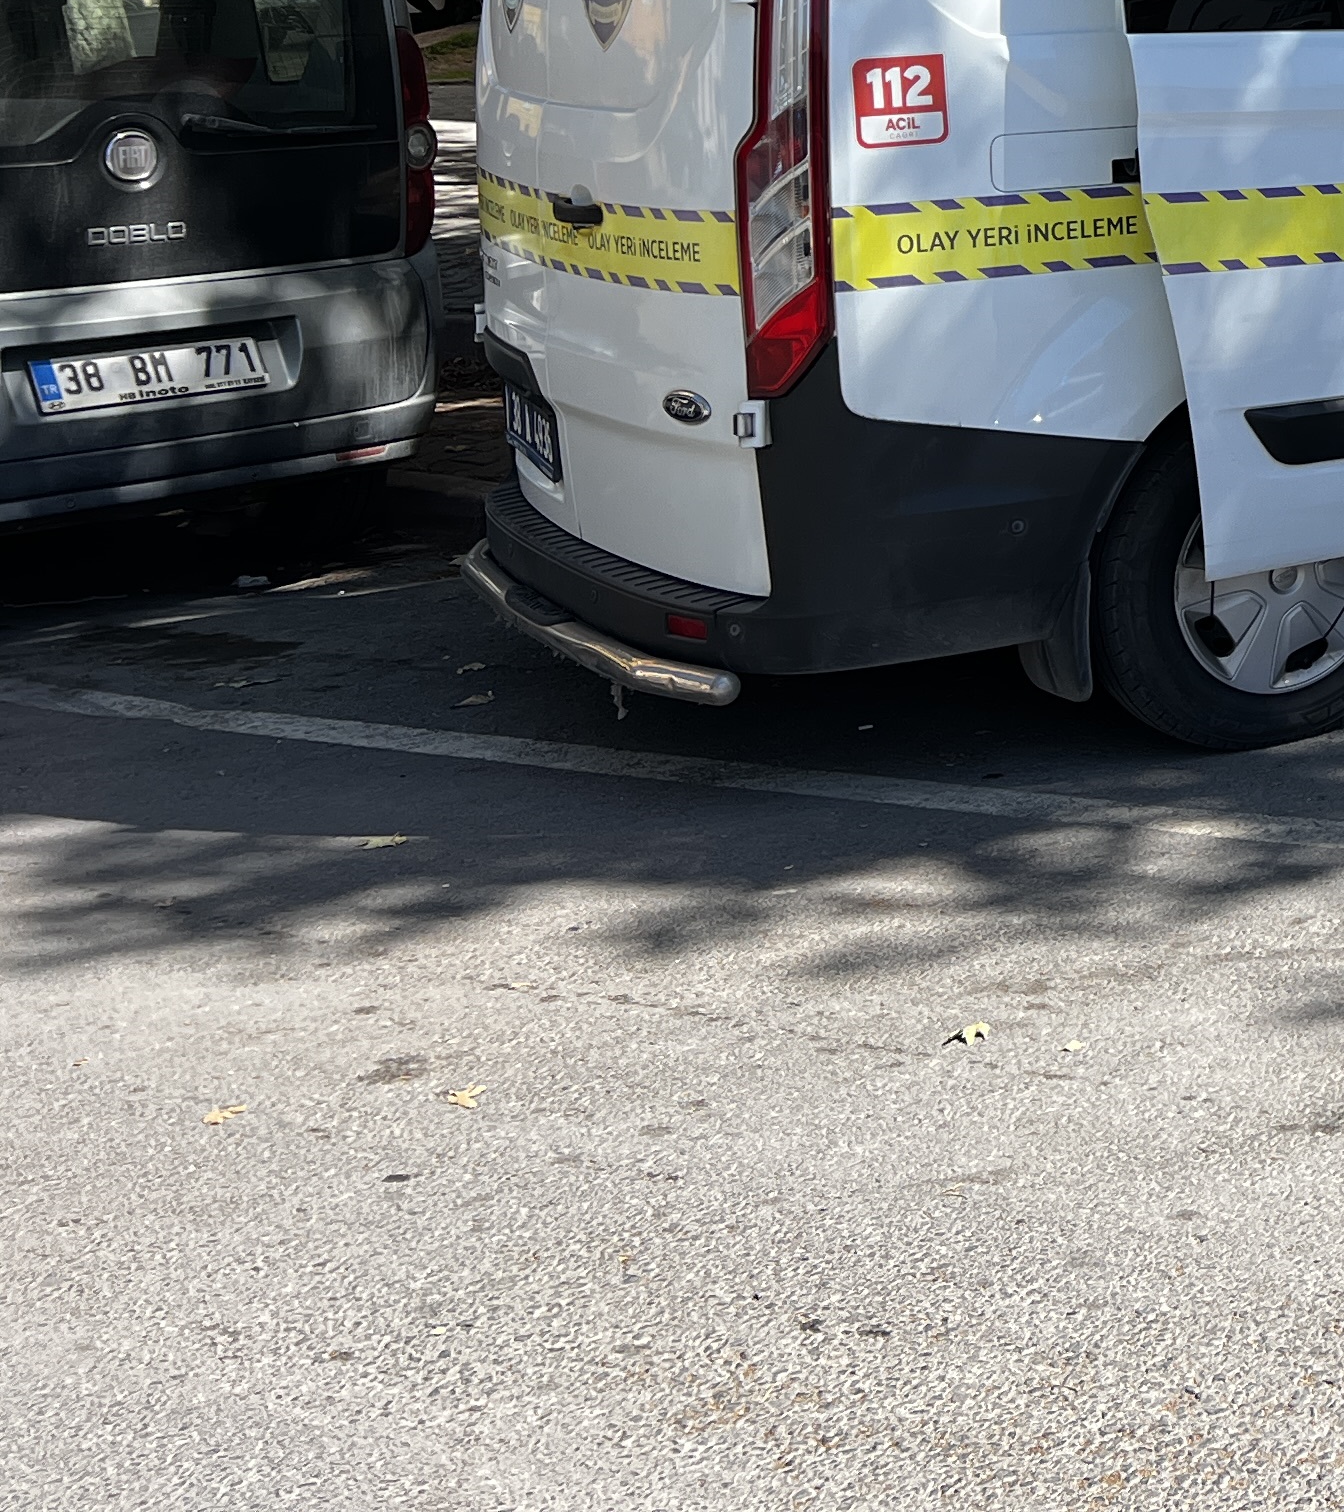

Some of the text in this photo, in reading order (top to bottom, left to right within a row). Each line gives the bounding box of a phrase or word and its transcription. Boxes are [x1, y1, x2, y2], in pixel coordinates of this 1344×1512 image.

[866, 64, 933, 110] 112
[885, 116, 921, 132] ACİL
[118, 145, 146, 169] FIAT
[87, 221, 186, 246] DOBLO
[588, 232, 611, 252] OLAY
[638, 241, 701, 263] İNCELEME
[897, 215, 1138, 255] OLAY YERİ İNCELEME
[41, 342, 257, 396] TR 38 BM 771
[669, 397, 696, 419] Ford
